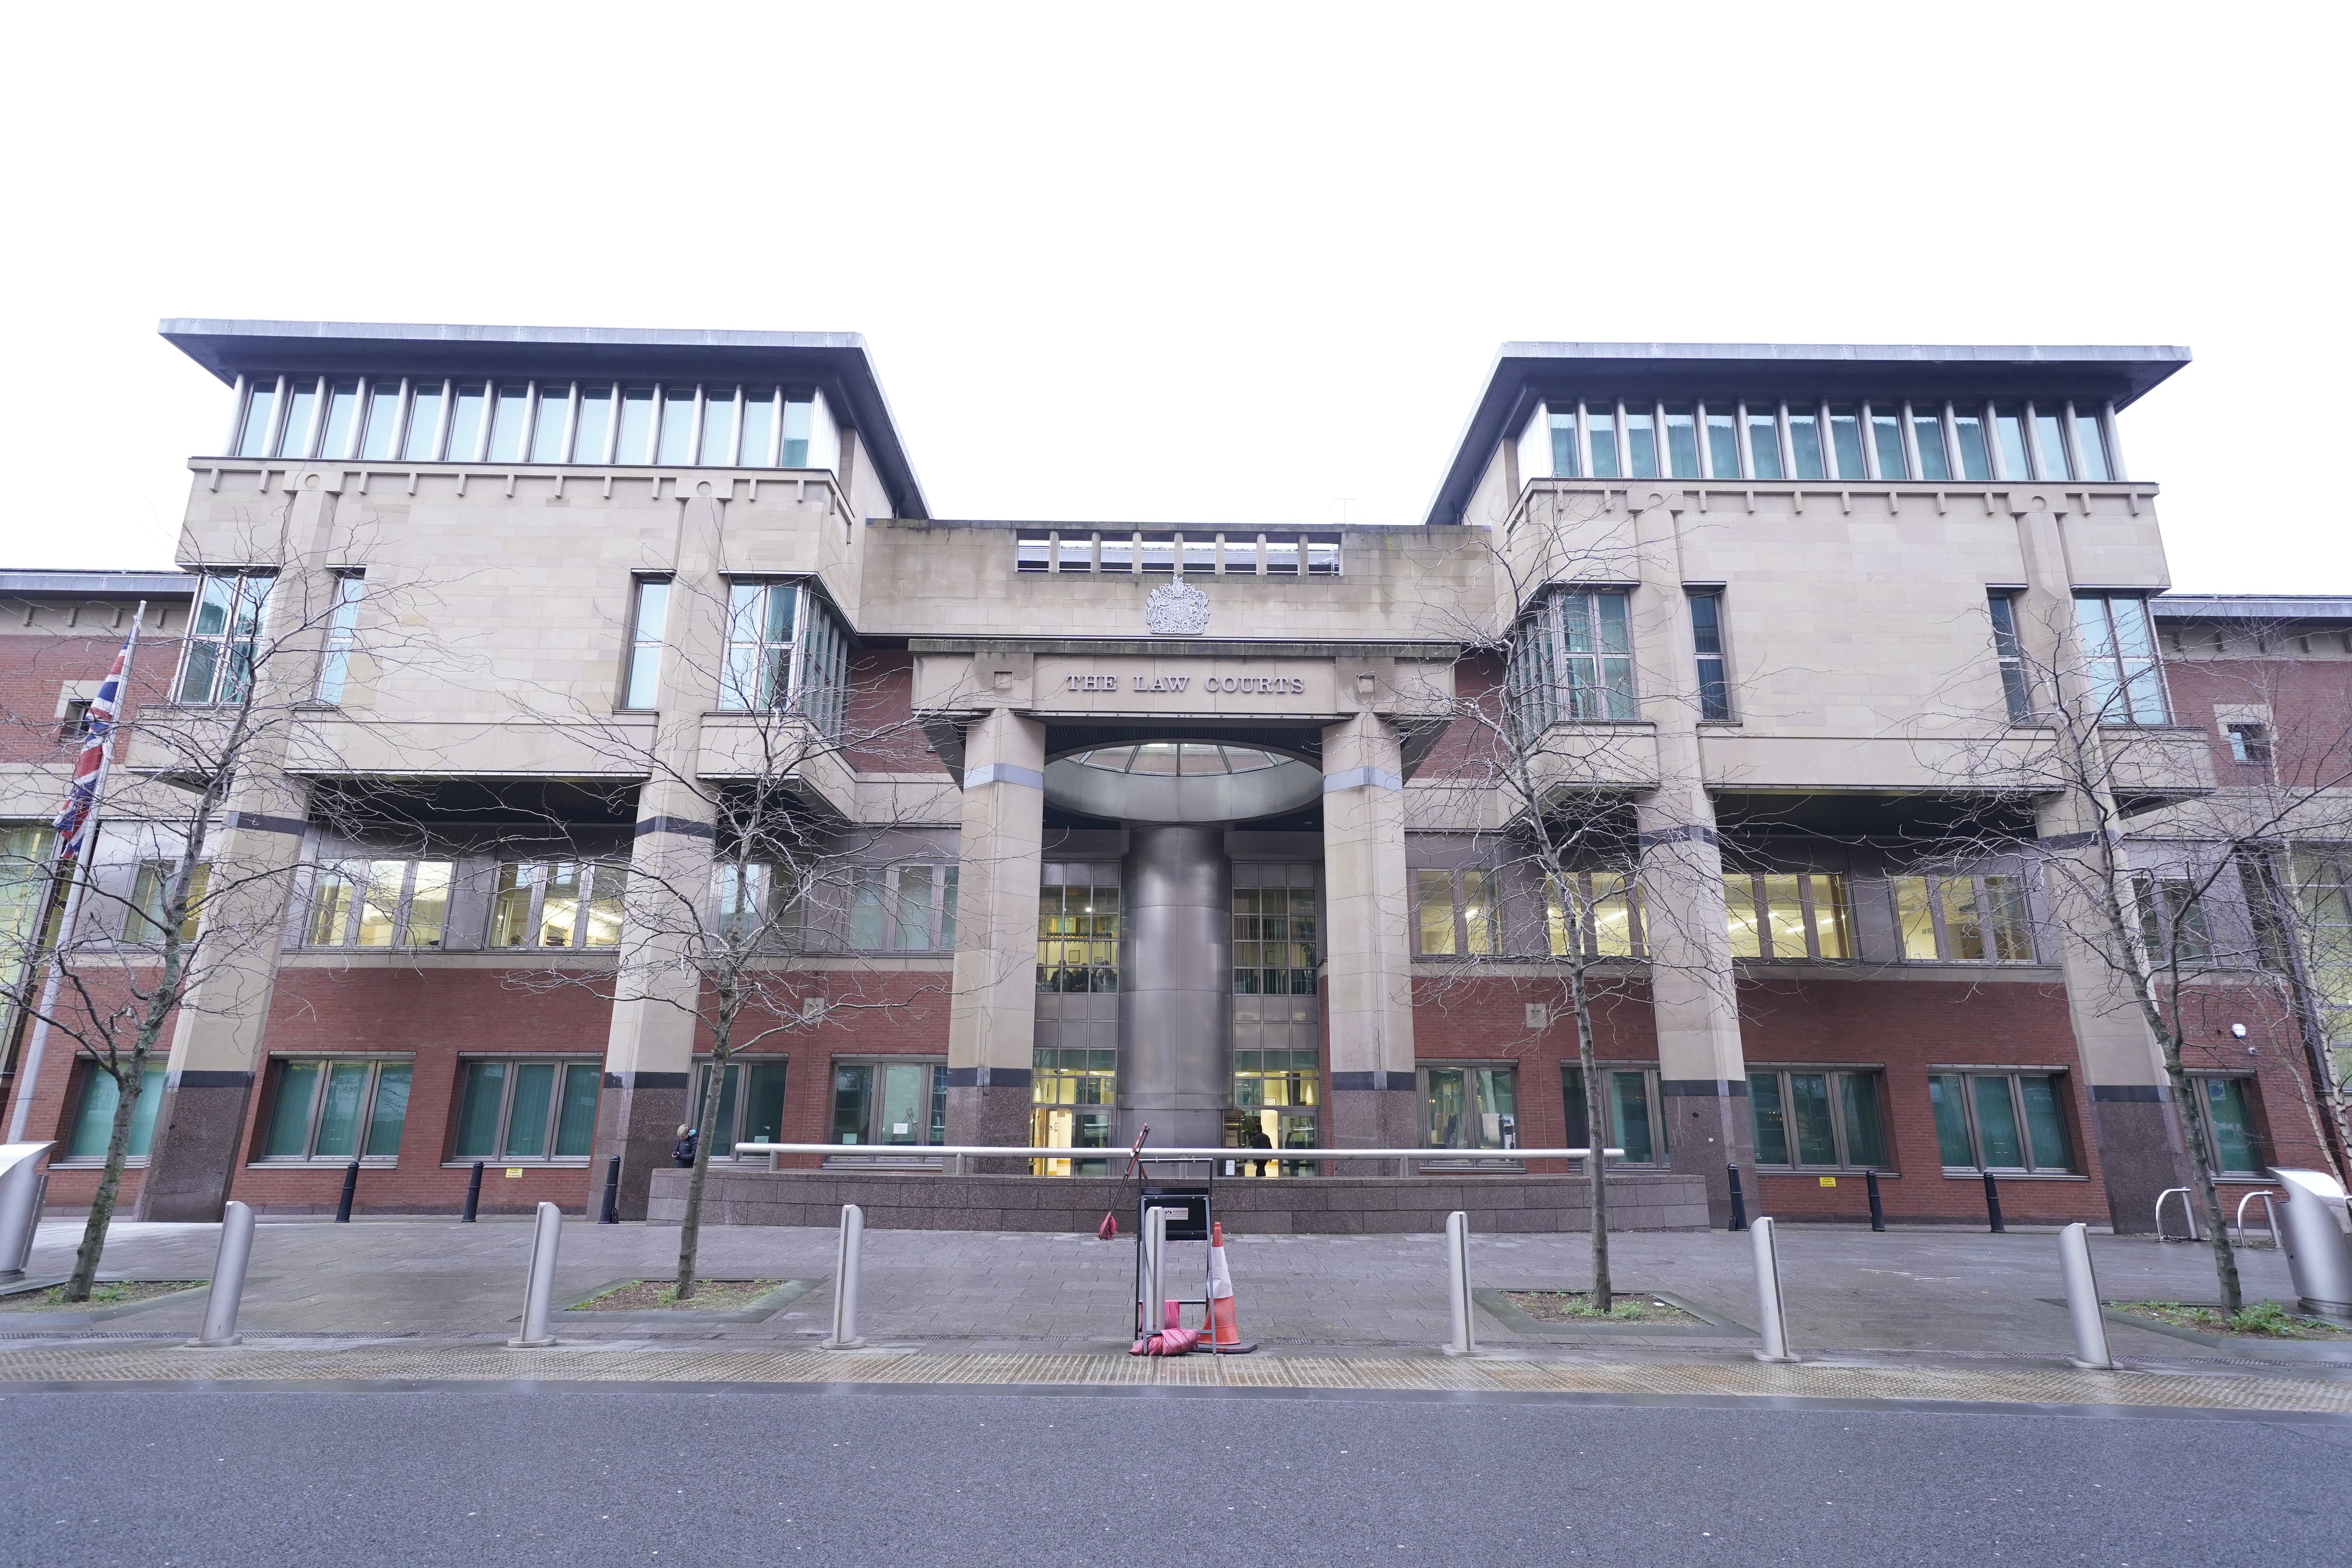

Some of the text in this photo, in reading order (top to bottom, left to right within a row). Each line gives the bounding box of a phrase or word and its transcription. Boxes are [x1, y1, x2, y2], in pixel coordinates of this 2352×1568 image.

[1066, 675, 1304, 693] THE LAW COURTS
